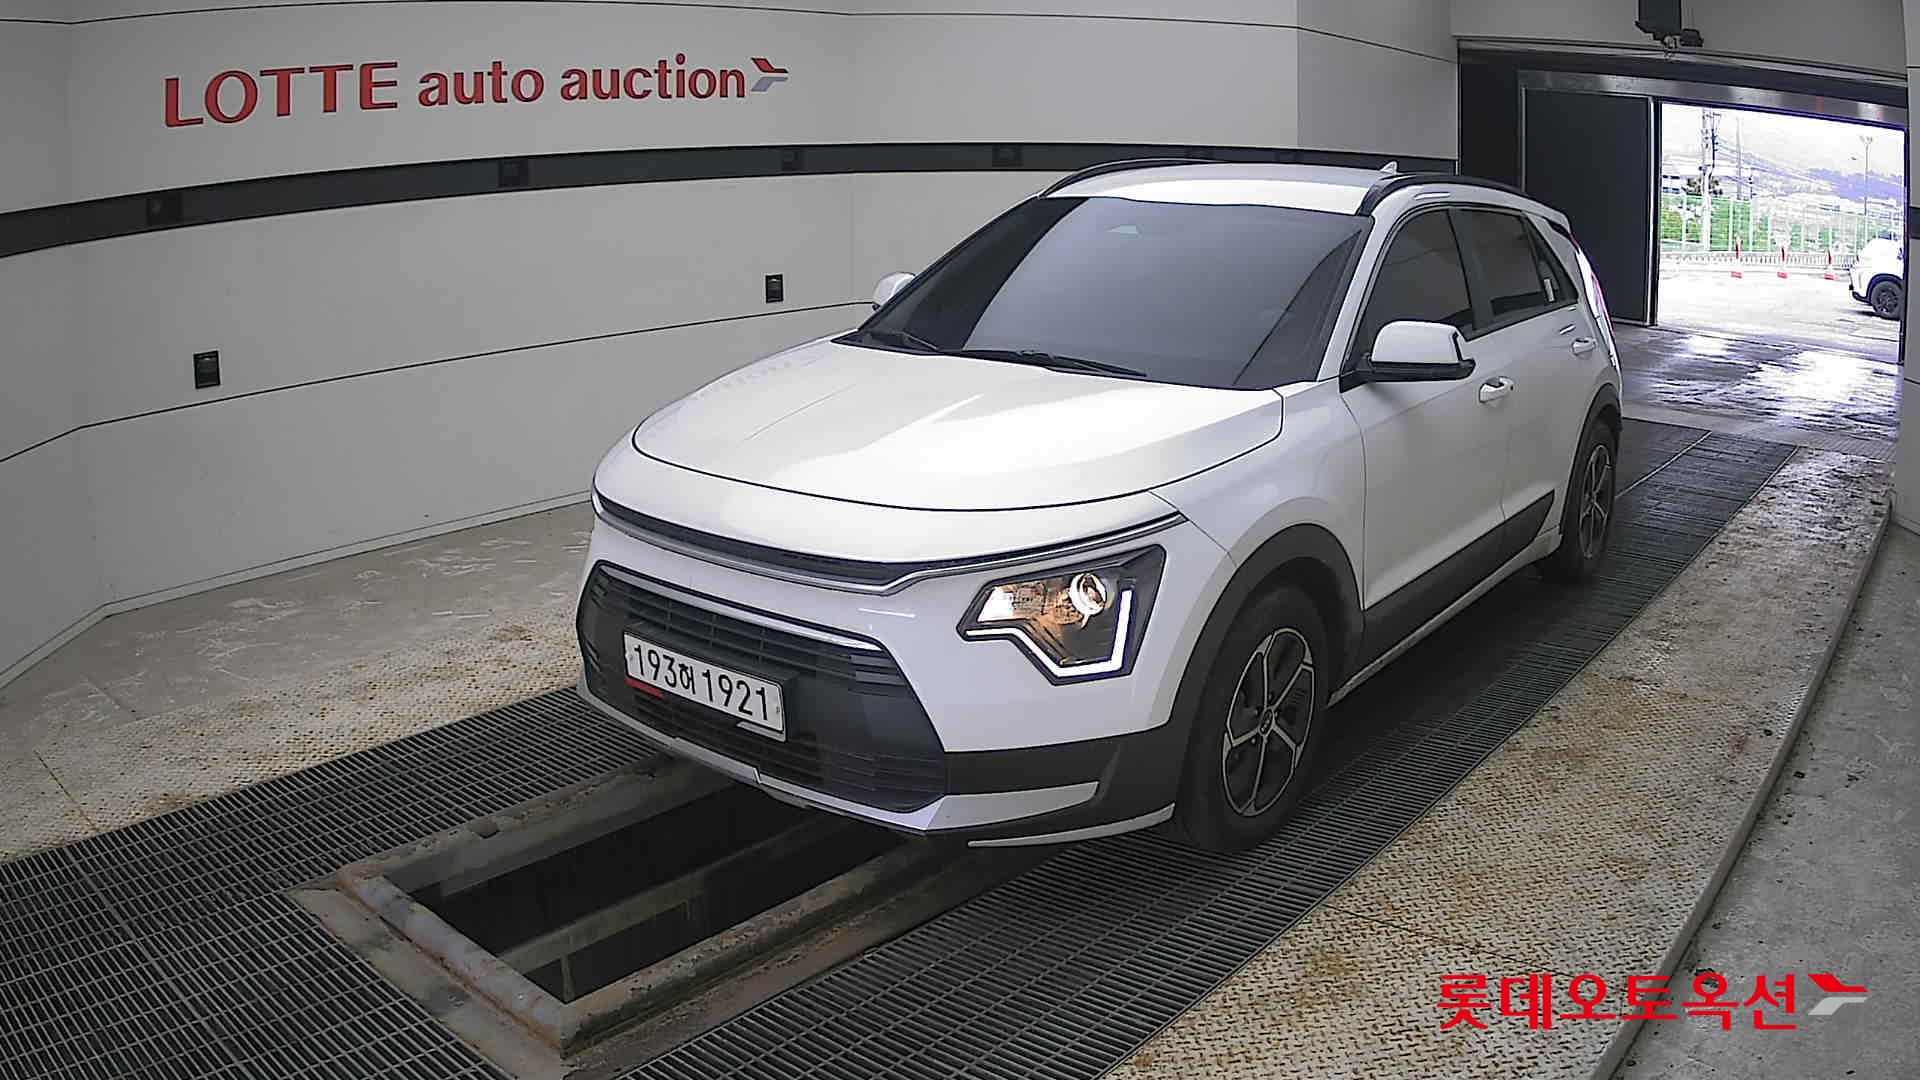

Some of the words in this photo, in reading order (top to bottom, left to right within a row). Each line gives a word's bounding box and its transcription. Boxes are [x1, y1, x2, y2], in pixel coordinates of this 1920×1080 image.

[163, 61, 398, 127] LOTTE
[417, 60, 544, 107] auto
[560, 53, 746, 100] auction
